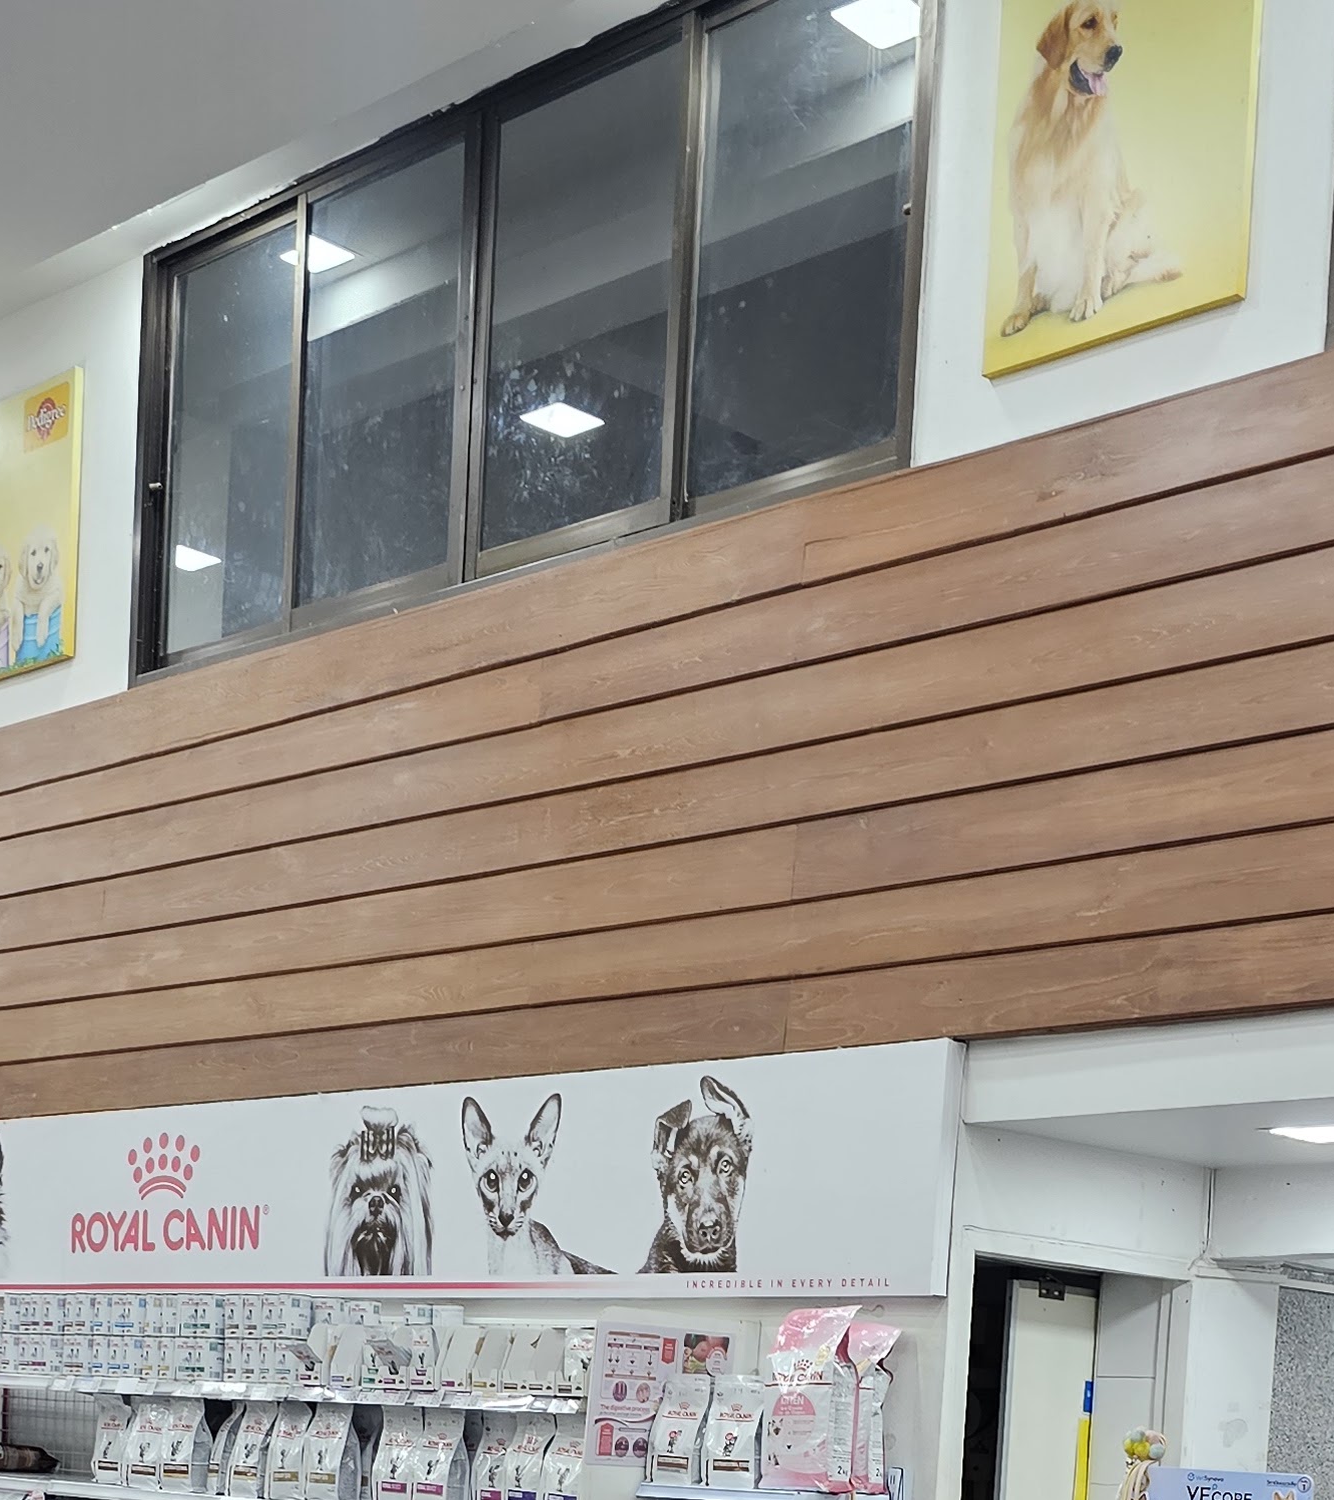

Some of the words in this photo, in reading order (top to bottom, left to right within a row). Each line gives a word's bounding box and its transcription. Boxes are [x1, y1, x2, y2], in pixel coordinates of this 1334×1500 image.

[71, 1210, 156, 1253] ROYAL
[163, 1204, 261, 1252] CANIN
[686, 1279, 763, 1289] INCREDIBLE
[770, 1279, 784, 1288] IN
[791, 1278, 833, 1288] EVERY
[841, 1277, 891, 1288] DETAIL
